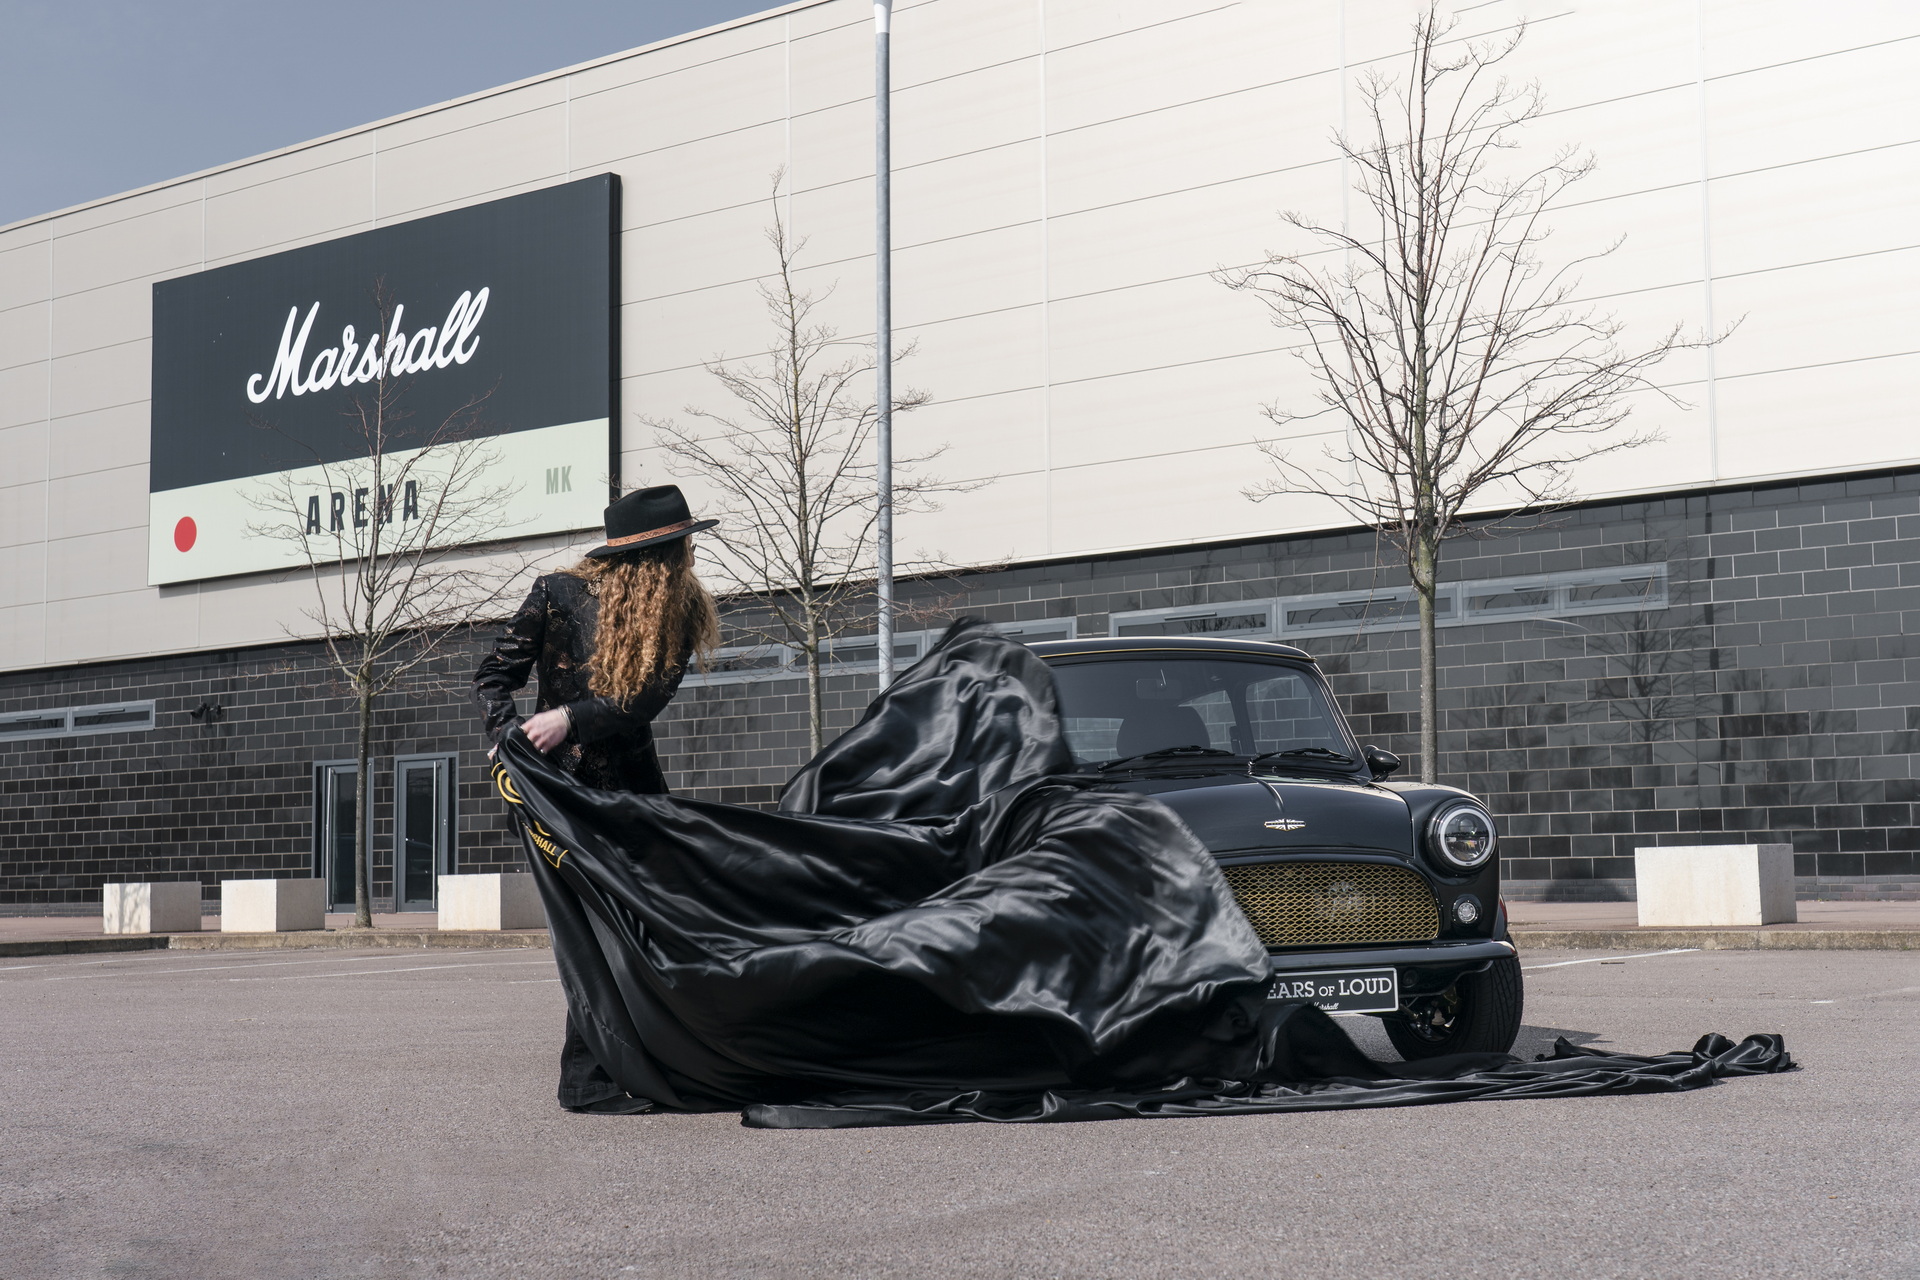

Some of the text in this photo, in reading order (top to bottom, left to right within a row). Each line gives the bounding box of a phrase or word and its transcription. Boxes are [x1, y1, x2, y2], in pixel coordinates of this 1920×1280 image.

[247, 287, 489, 403] Marshall
[546, 465, 572, 495] MK
[306, 480, 418, 535] ARENA
[1319, 986, 1335, 997] OF
[1338, 977, 1392, 996] LOUD
